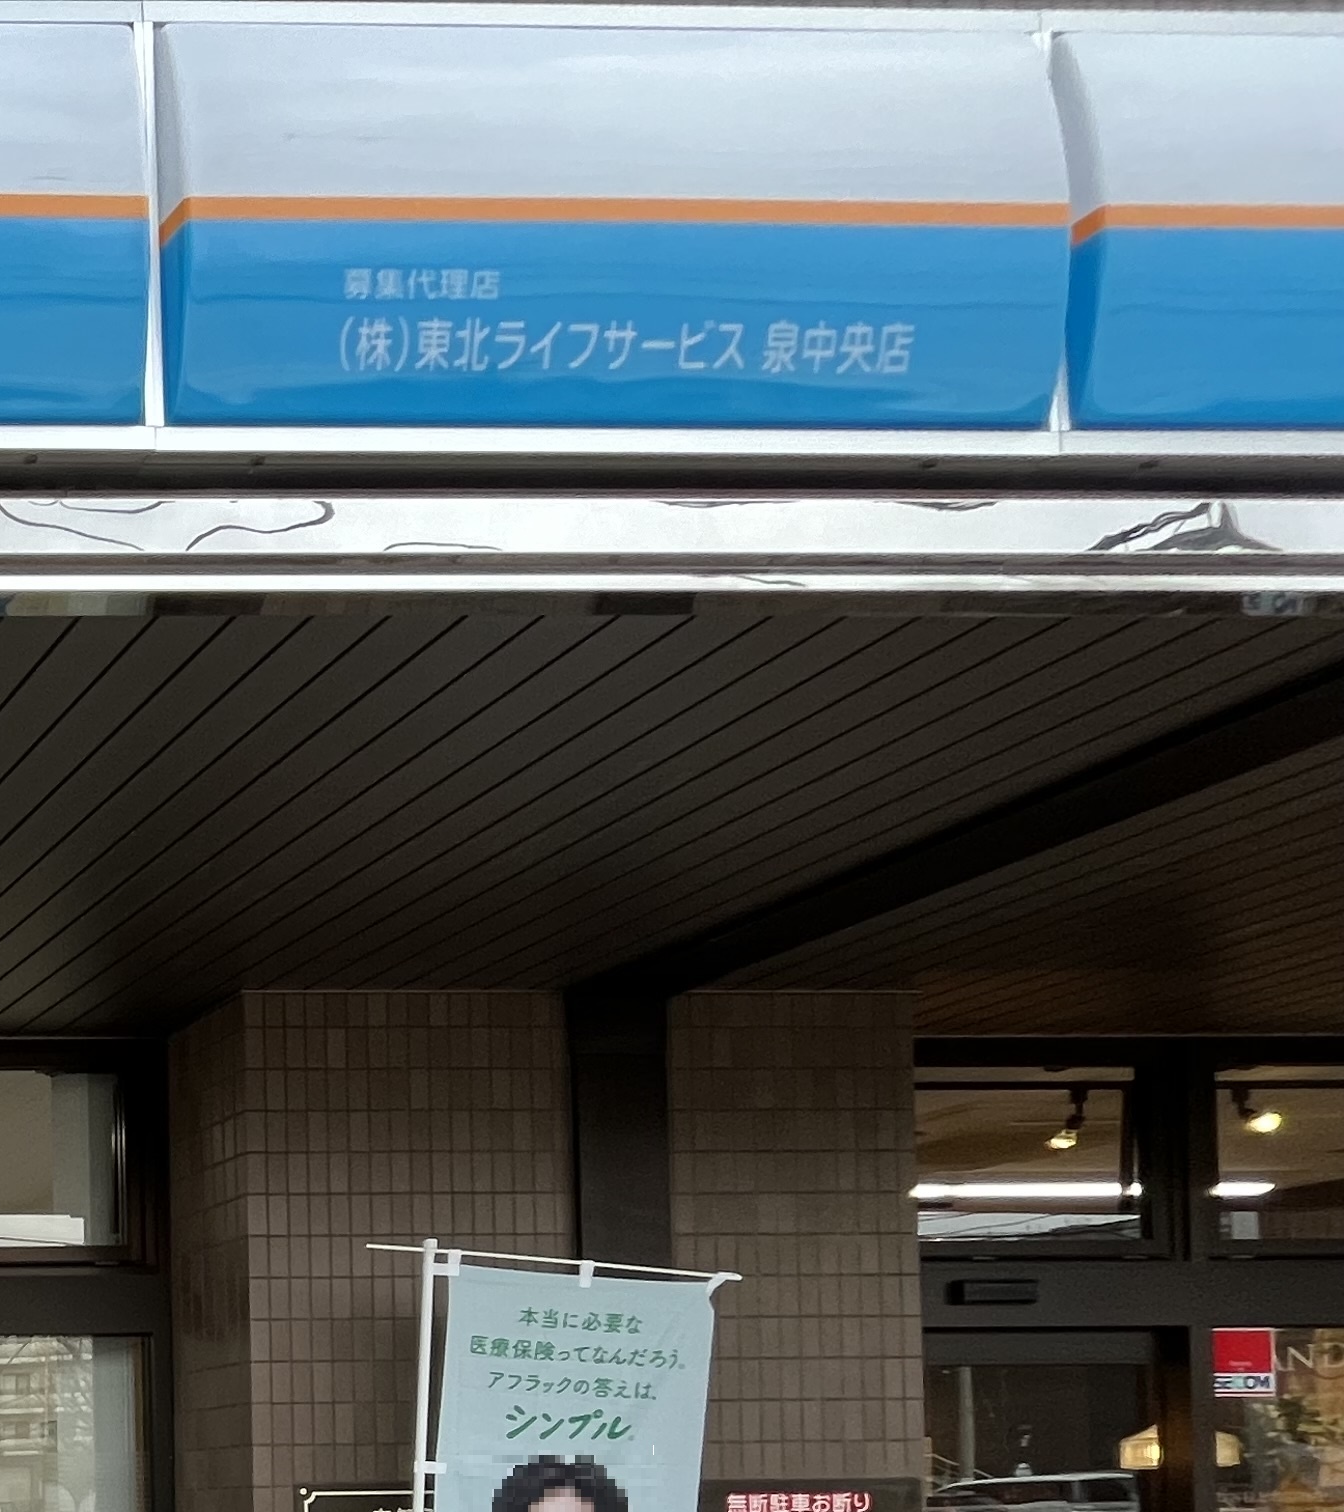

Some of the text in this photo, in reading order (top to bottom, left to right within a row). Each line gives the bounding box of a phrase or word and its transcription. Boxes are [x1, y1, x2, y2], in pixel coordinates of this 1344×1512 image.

[344, 267, 501, 302] 募集代理店
[518, 1307, 643, 1334] 本当に必要な
